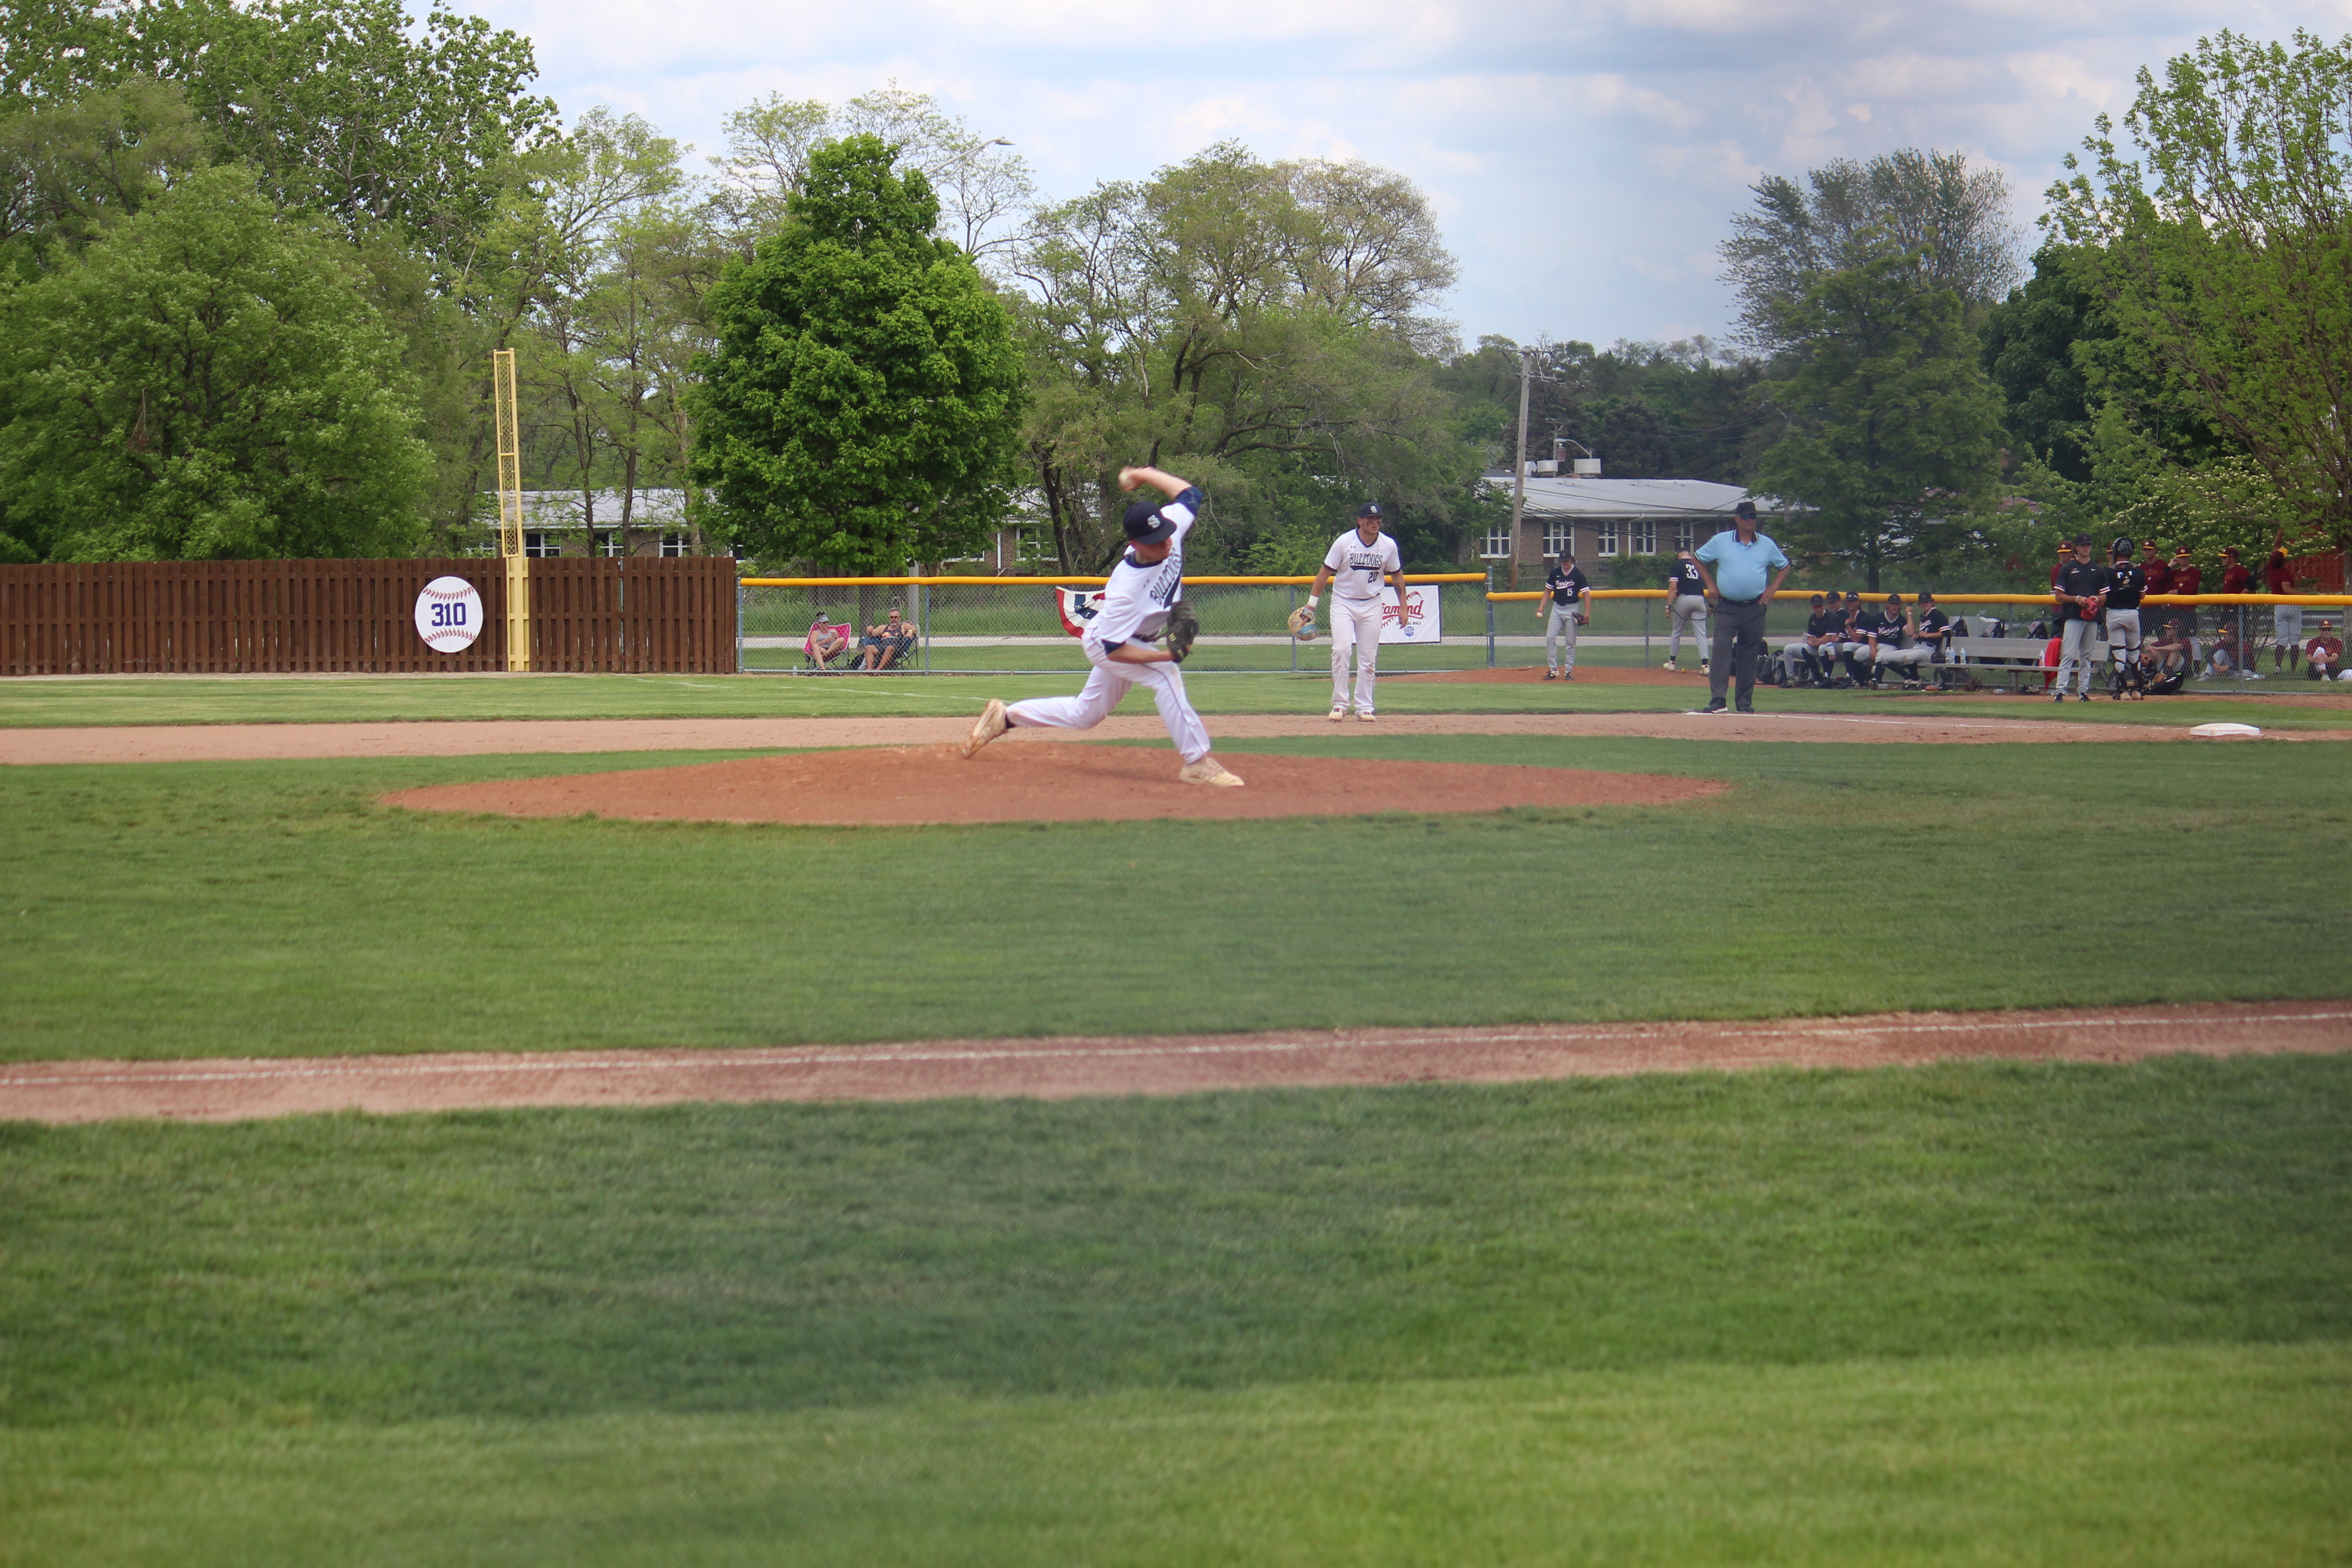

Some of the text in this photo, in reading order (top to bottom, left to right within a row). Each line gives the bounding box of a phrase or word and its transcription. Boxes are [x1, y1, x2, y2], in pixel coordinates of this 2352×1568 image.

[1350, 553, 1383, 567] BULLDOGS
[1368, 572, 1379, 583] 20
[1685, 564, 1699, 580] 33
[1567, 588, 1573, 597] 15
[431, 602, 466, 627] 310
